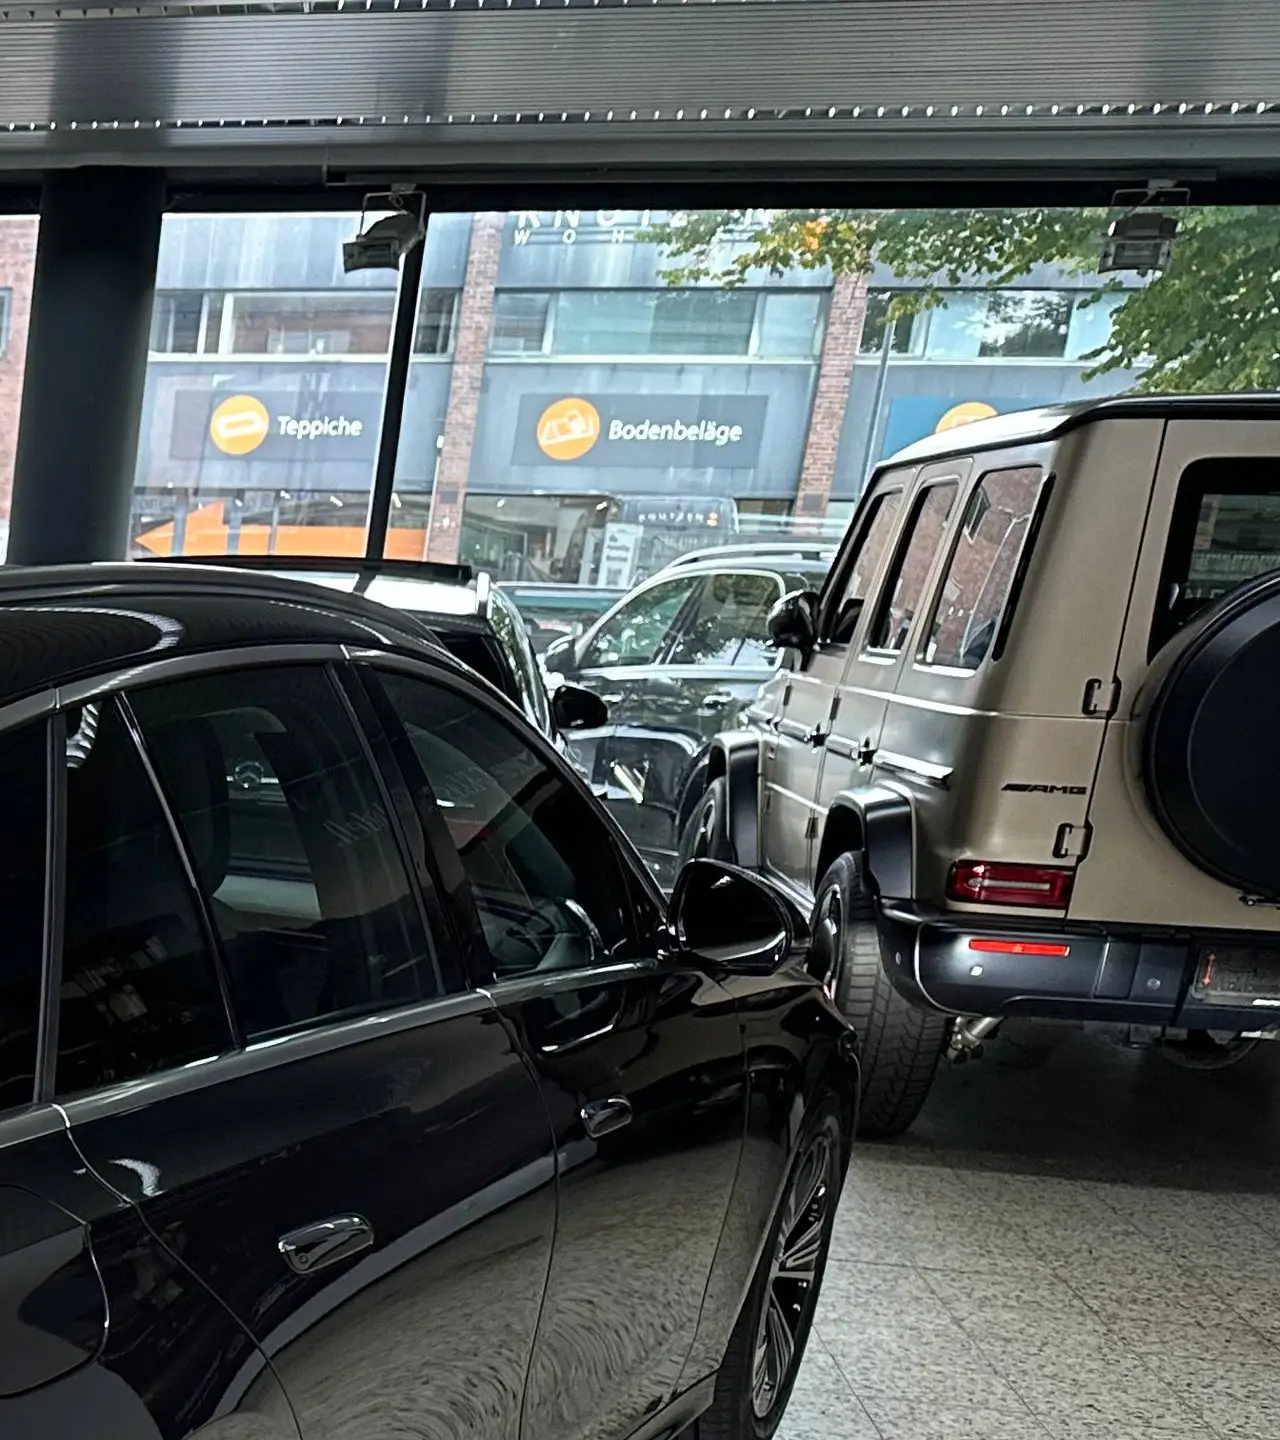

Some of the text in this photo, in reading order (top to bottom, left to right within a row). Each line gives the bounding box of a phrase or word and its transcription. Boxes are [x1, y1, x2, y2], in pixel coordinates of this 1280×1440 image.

[277, 415, 363, 440] Teppiche
[608, 418, 743, 446] Bodenbeläge
[1027, 784, 1088, 796] AMG
